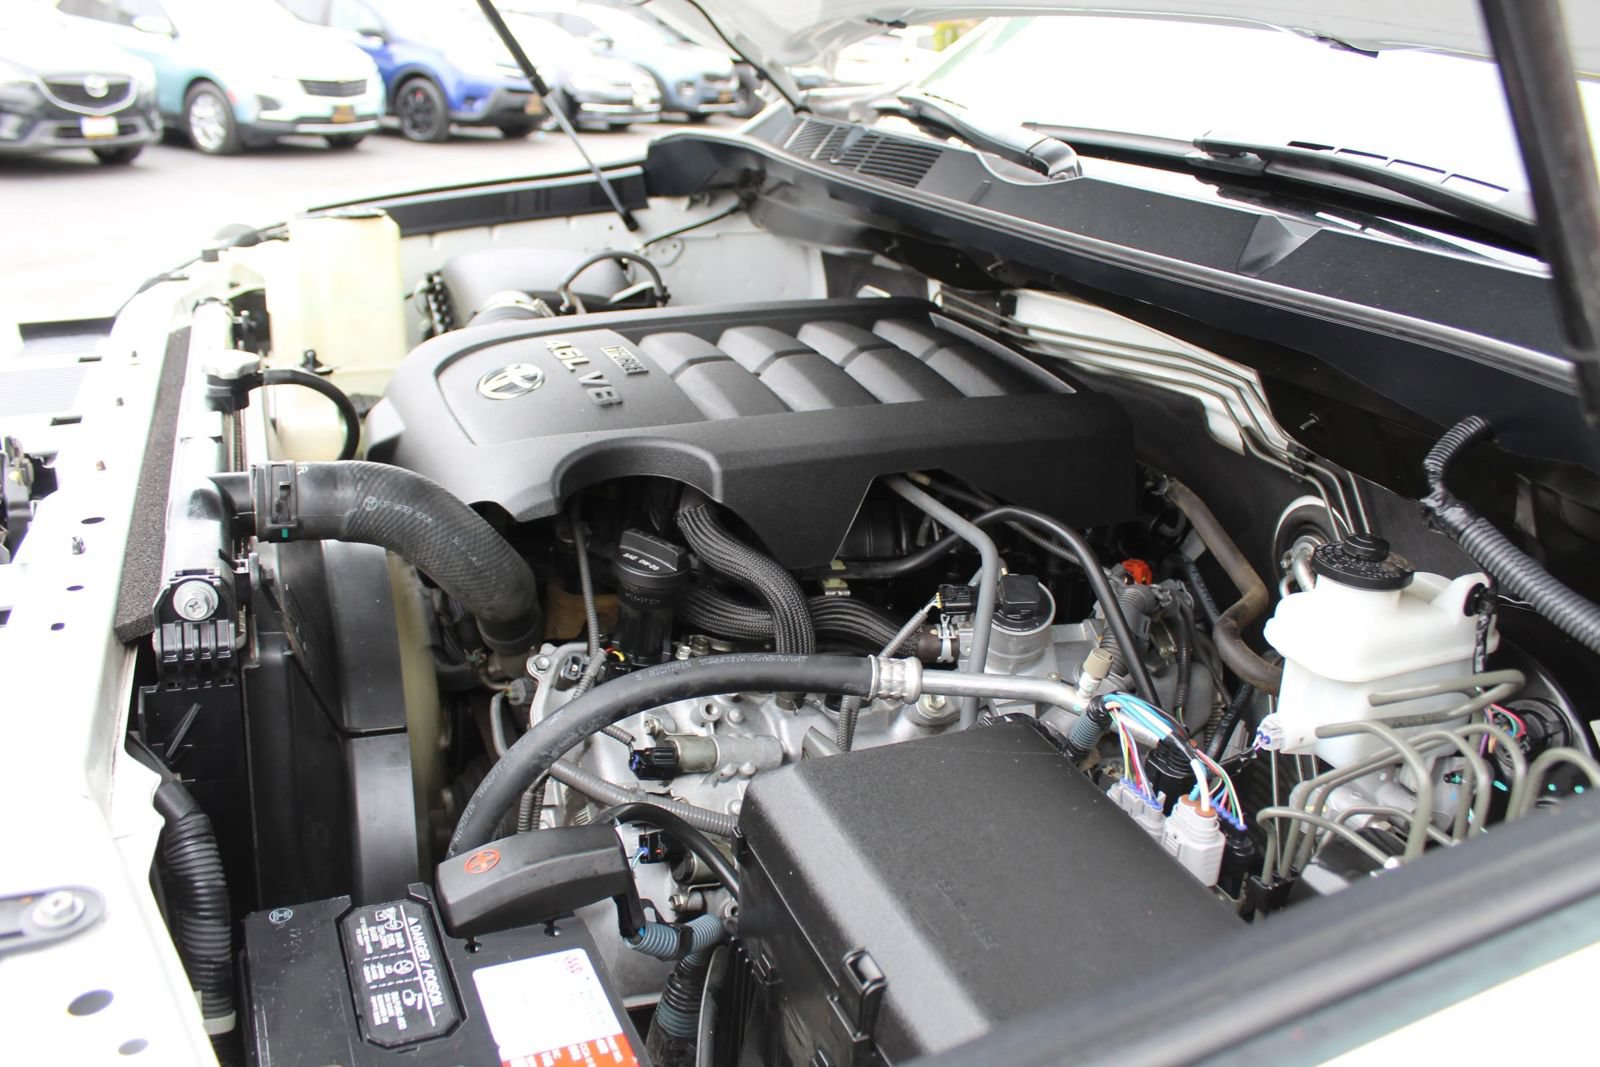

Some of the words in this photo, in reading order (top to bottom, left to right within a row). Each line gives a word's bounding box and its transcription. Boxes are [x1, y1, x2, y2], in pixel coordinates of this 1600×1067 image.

[578, 370, 623, 406] V8
[410, 924, 431, 962] DANGER
[422, 968, 444, 1007] POISON
